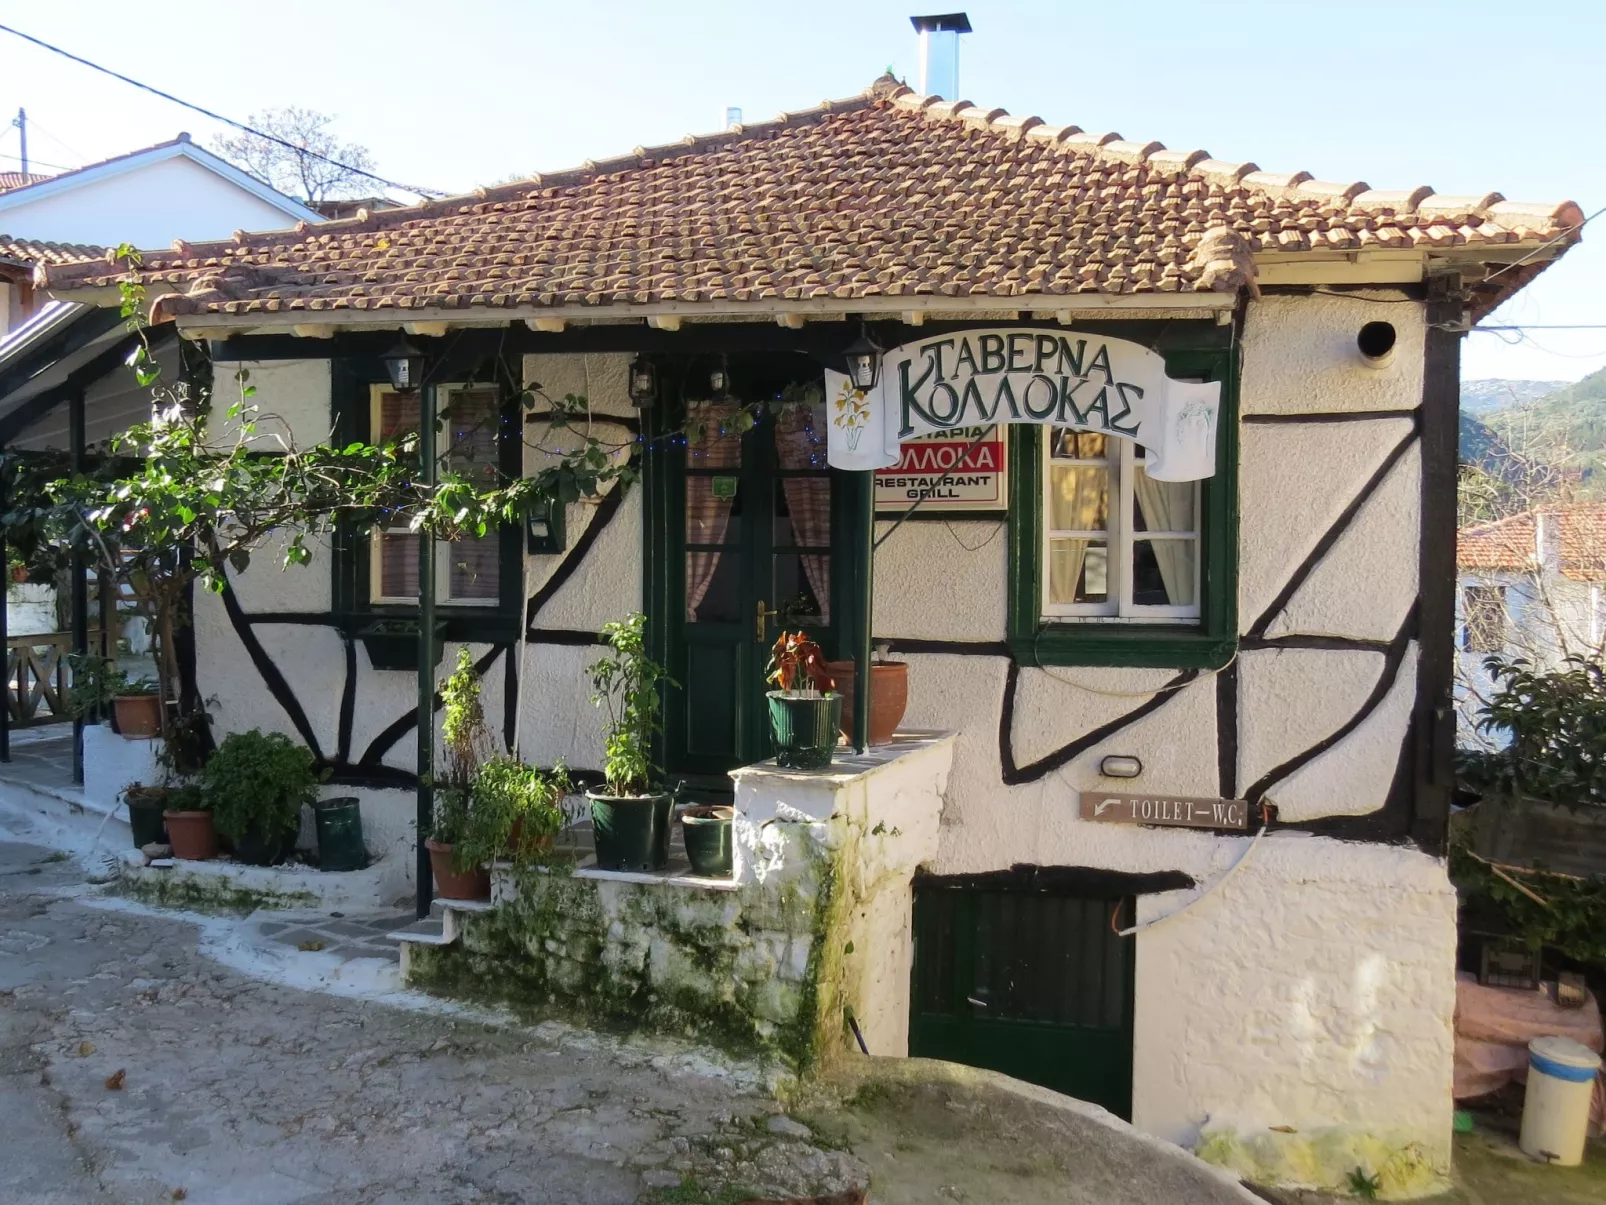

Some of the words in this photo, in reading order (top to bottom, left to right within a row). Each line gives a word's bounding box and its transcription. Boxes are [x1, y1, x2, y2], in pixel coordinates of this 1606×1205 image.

[920, 333, 1114, 388] ΤΑΒΕΡΝΑ
[898, 354, 1145, 439] ΚΟΛΛΟΚΑΣ
[881, 446, 995, 470] ΛΛΟΚΑ
[875, 476, 991, 488] RESTAURANT
[906, 487, 960, 499] GRILL
